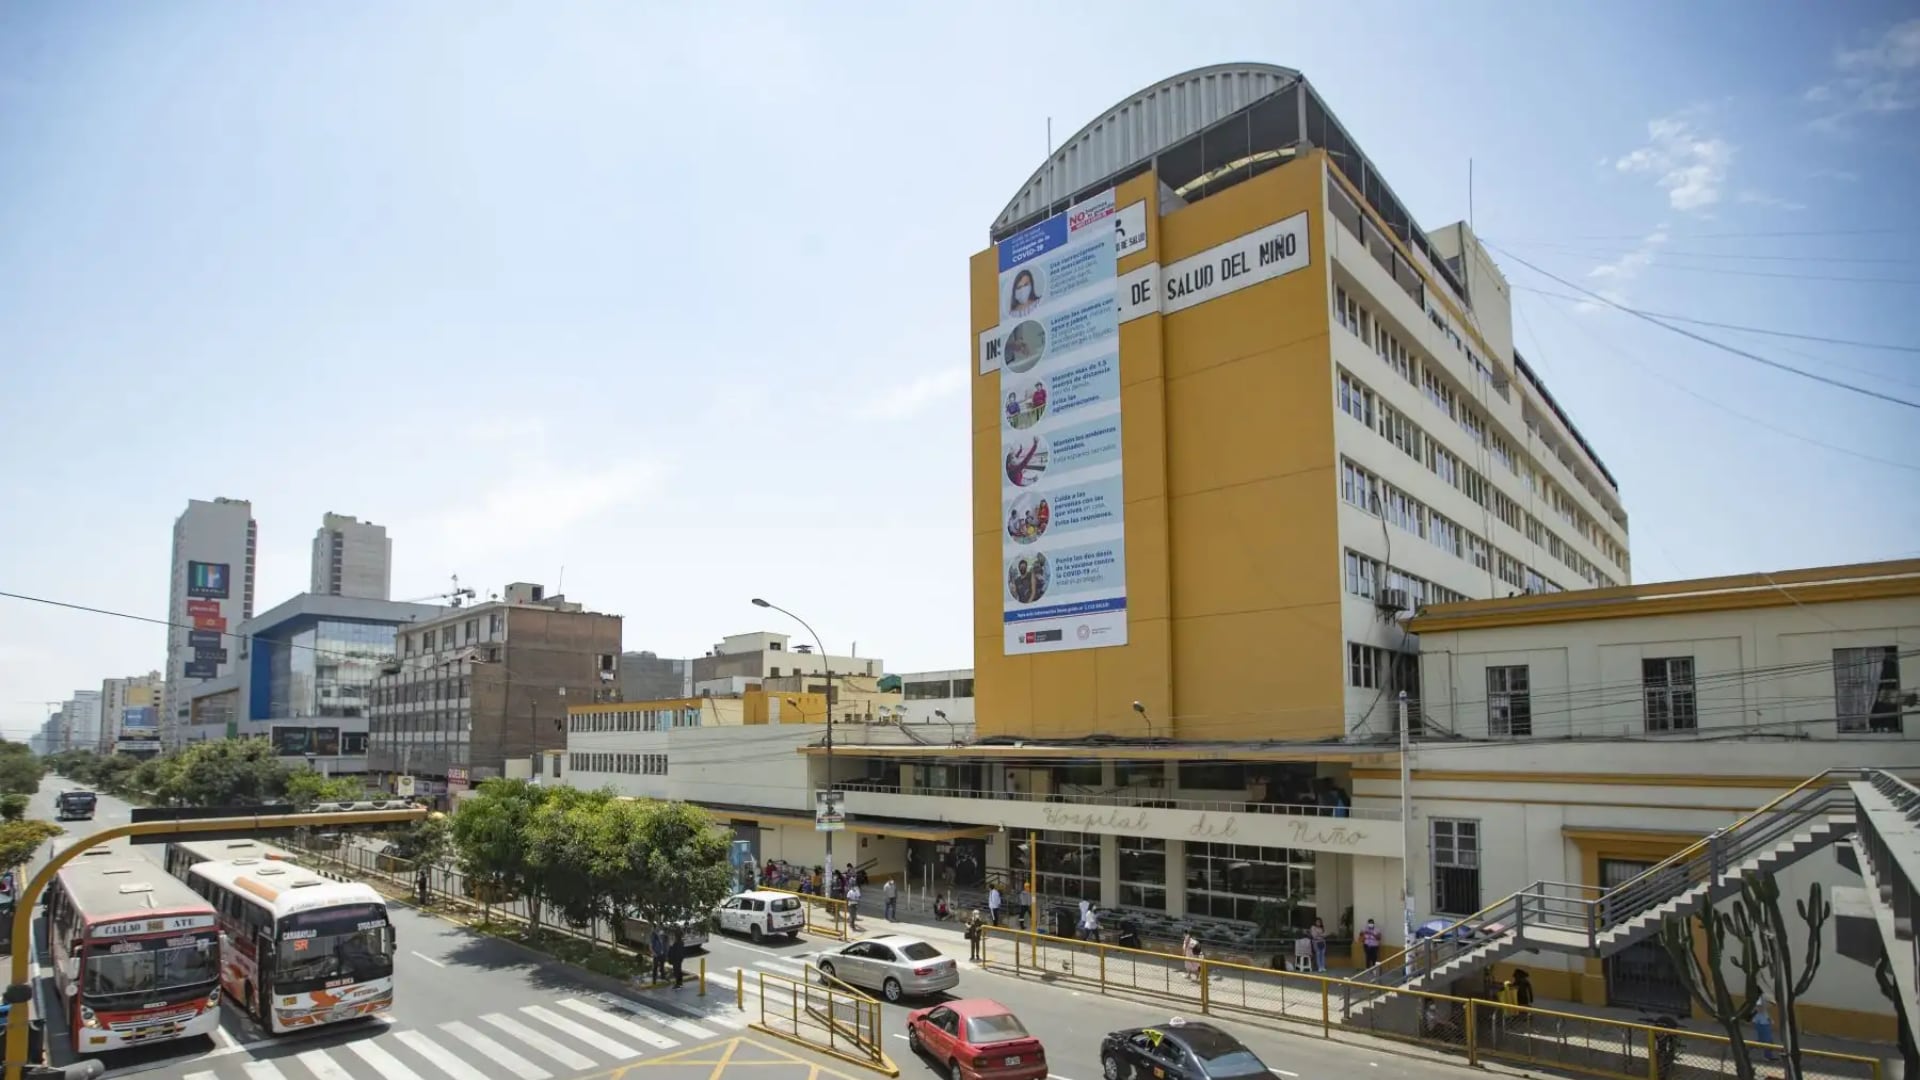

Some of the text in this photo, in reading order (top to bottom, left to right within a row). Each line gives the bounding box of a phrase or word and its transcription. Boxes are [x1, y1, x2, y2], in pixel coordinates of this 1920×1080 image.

[1070, 212, 1085, 226] NO
[1129, 232, 1145, 246] SALUD
[1012, 244, 1044, 262] COVID-19
[1131, 278, 1151, 306] DE
[1167, 264, 1213, 300] SALUD
[1221, 251, 1251, 281] DEL
[1055, 518, 1069, 527] Evita
[1062, 569, 1090, 578] COVID-19
[1042, 807, 1370, 845] Hospital del Niño
[104, 923, 141, 935] CALLAO
[173, 918, 195, 928] ATE
